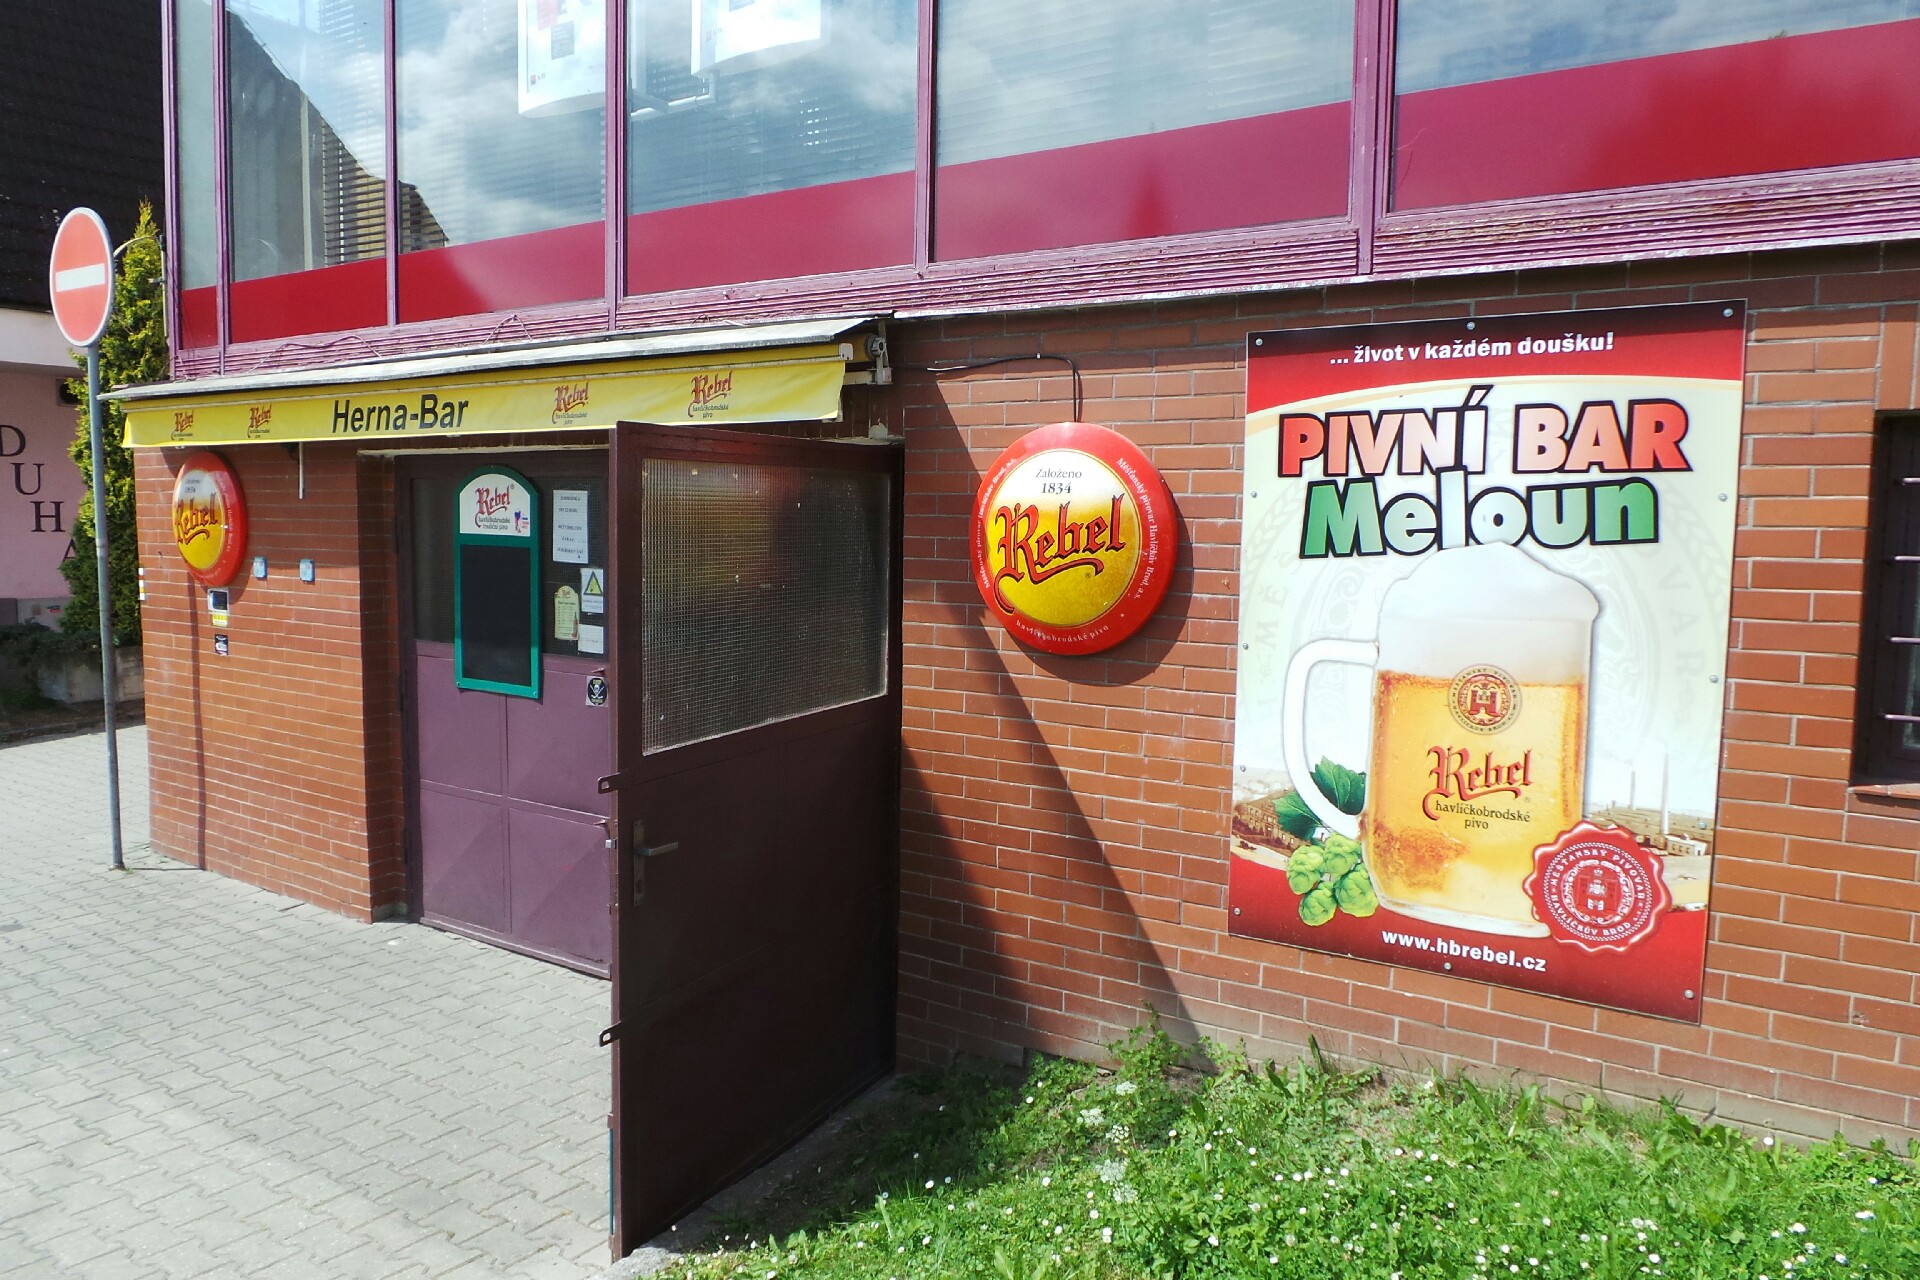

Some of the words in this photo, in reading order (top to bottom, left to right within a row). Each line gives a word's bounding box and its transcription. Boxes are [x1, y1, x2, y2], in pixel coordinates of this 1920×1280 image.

[1353, 344, 1404, 363] život
[1408, 347, 1420, 360] v
[1424, 337, 1511, 360] každém
[1517, 331, 1614, 355] doušku!
[332, 394, 469, 433] Herna-Bar
[552, 381, 590, 424] Rebel
[688, 370, 733, 417] Rebel
[1277, 384, 1494, 477] PIVNÍ
[1512, 397, 1693, 474] BAR
[1035, 468, 1082, 478] Založeno
[1041, 481, 1072, 495] 1834
[475, 485, 510, 528] Rebel
[1299, 465, 1659, 559] Meloun
[993, 493, 1126, 614] Rebel
[1422, 746, 1534, 821] Rebel
[1435, 800, 1531, 822] havlíčkobrodské
[1464, 817, 1489, 829] pivo
[1381, 930, 1547, 972] www.hbrebel.cz
